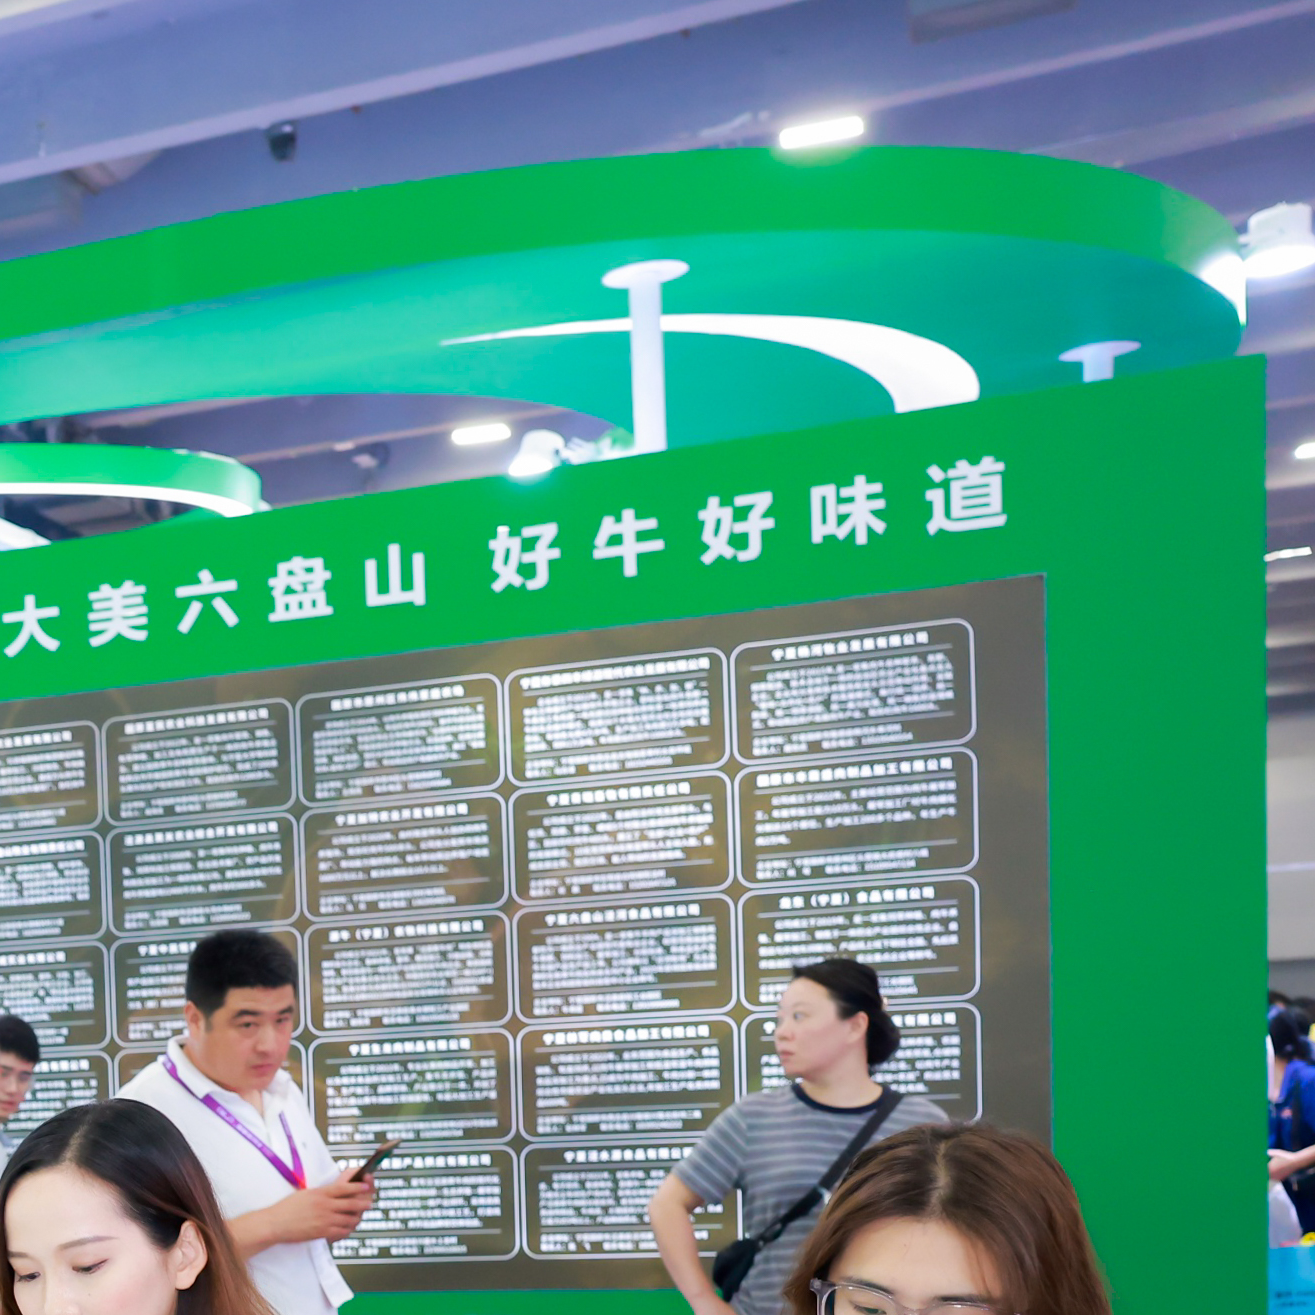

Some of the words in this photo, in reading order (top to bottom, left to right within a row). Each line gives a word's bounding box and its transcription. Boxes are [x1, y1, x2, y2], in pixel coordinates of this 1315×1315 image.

[1, 542, 428, 658] 大美六盘山
[488, 456, 1009, 595] 好牛好味道
